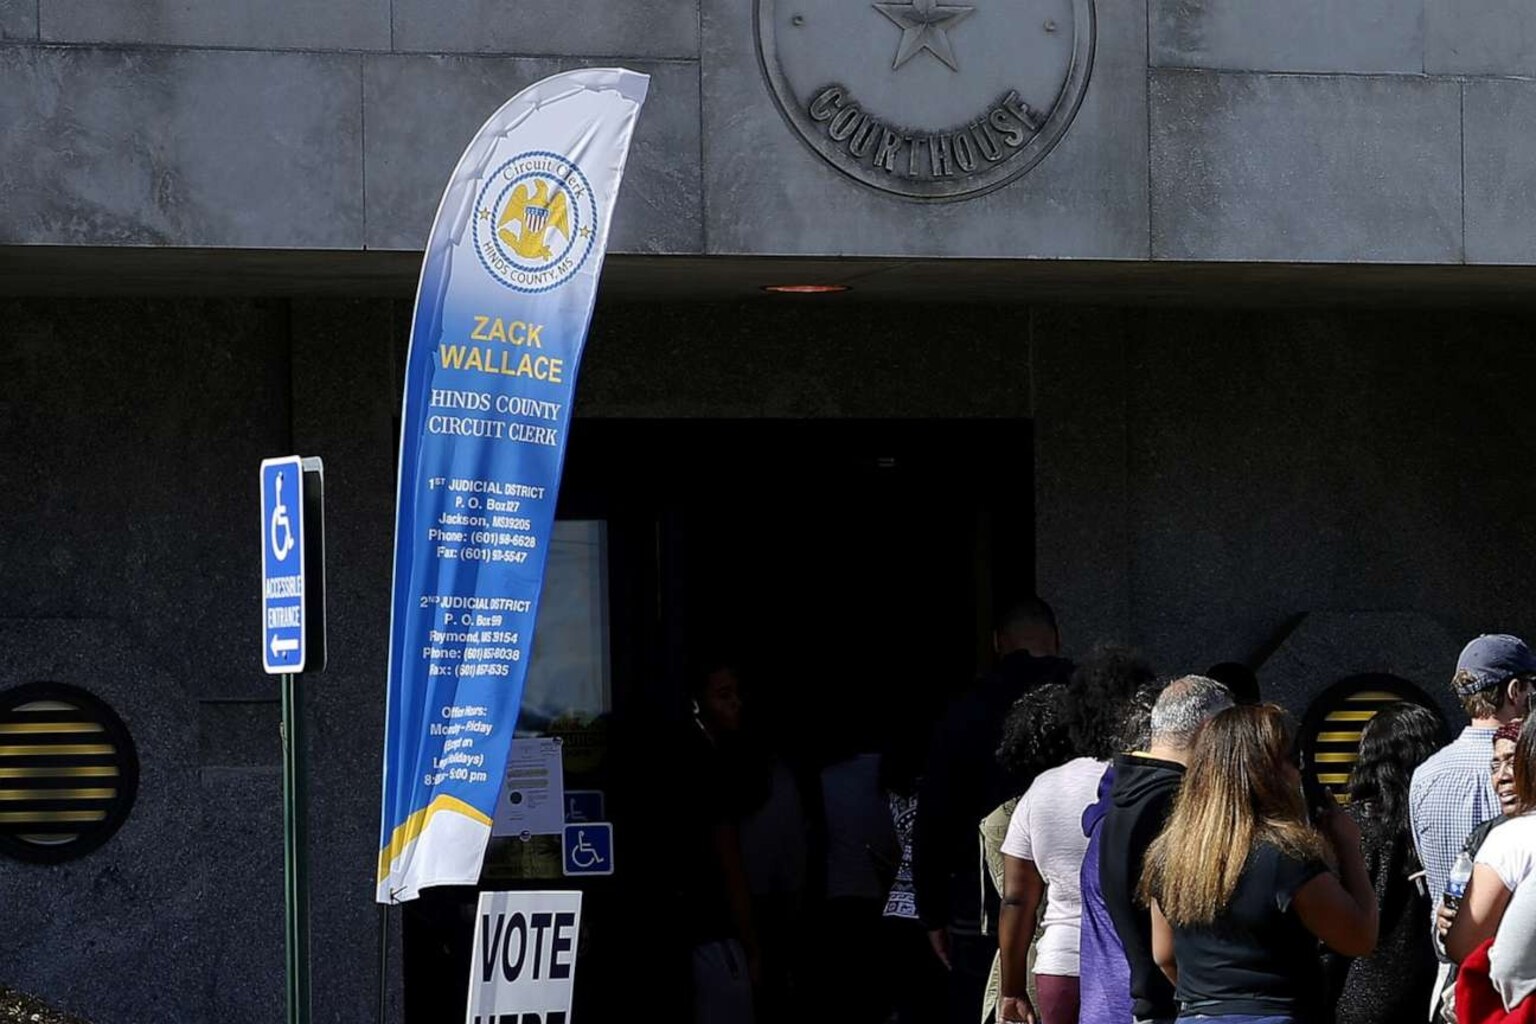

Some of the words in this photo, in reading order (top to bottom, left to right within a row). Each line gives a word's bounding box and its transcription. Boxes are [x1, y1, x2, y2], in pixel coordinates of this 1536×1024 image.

[808, 86, 1037, 176] COURTHOUSE
[503, 160, 552, 181] Circuit
[556, 162, 586, 199] Clerk
[483, 242, 508, 275] HINDS
[558, 258, 575, 275] MS
[471, 315, 545, 348] ZACK
[439, 344, 563, 383] WALLACE
[430, 389, 491, 411] HINDS
[496, 395, 561, 421] COUNTY
[428, 416, 505, 438] CIRCUIT
[508, 423, 557, 446] CLERK
[428, 478, 446, 490] 1ST
[448, 479, 502, 494] JUDICIAL
[428, 528, 467, 542] Phone:
[438, 512, 490, 529] Jackson,
[268, 606, 301, 628] ENTRANCE
[482, 912, 576, 983] VOTE
